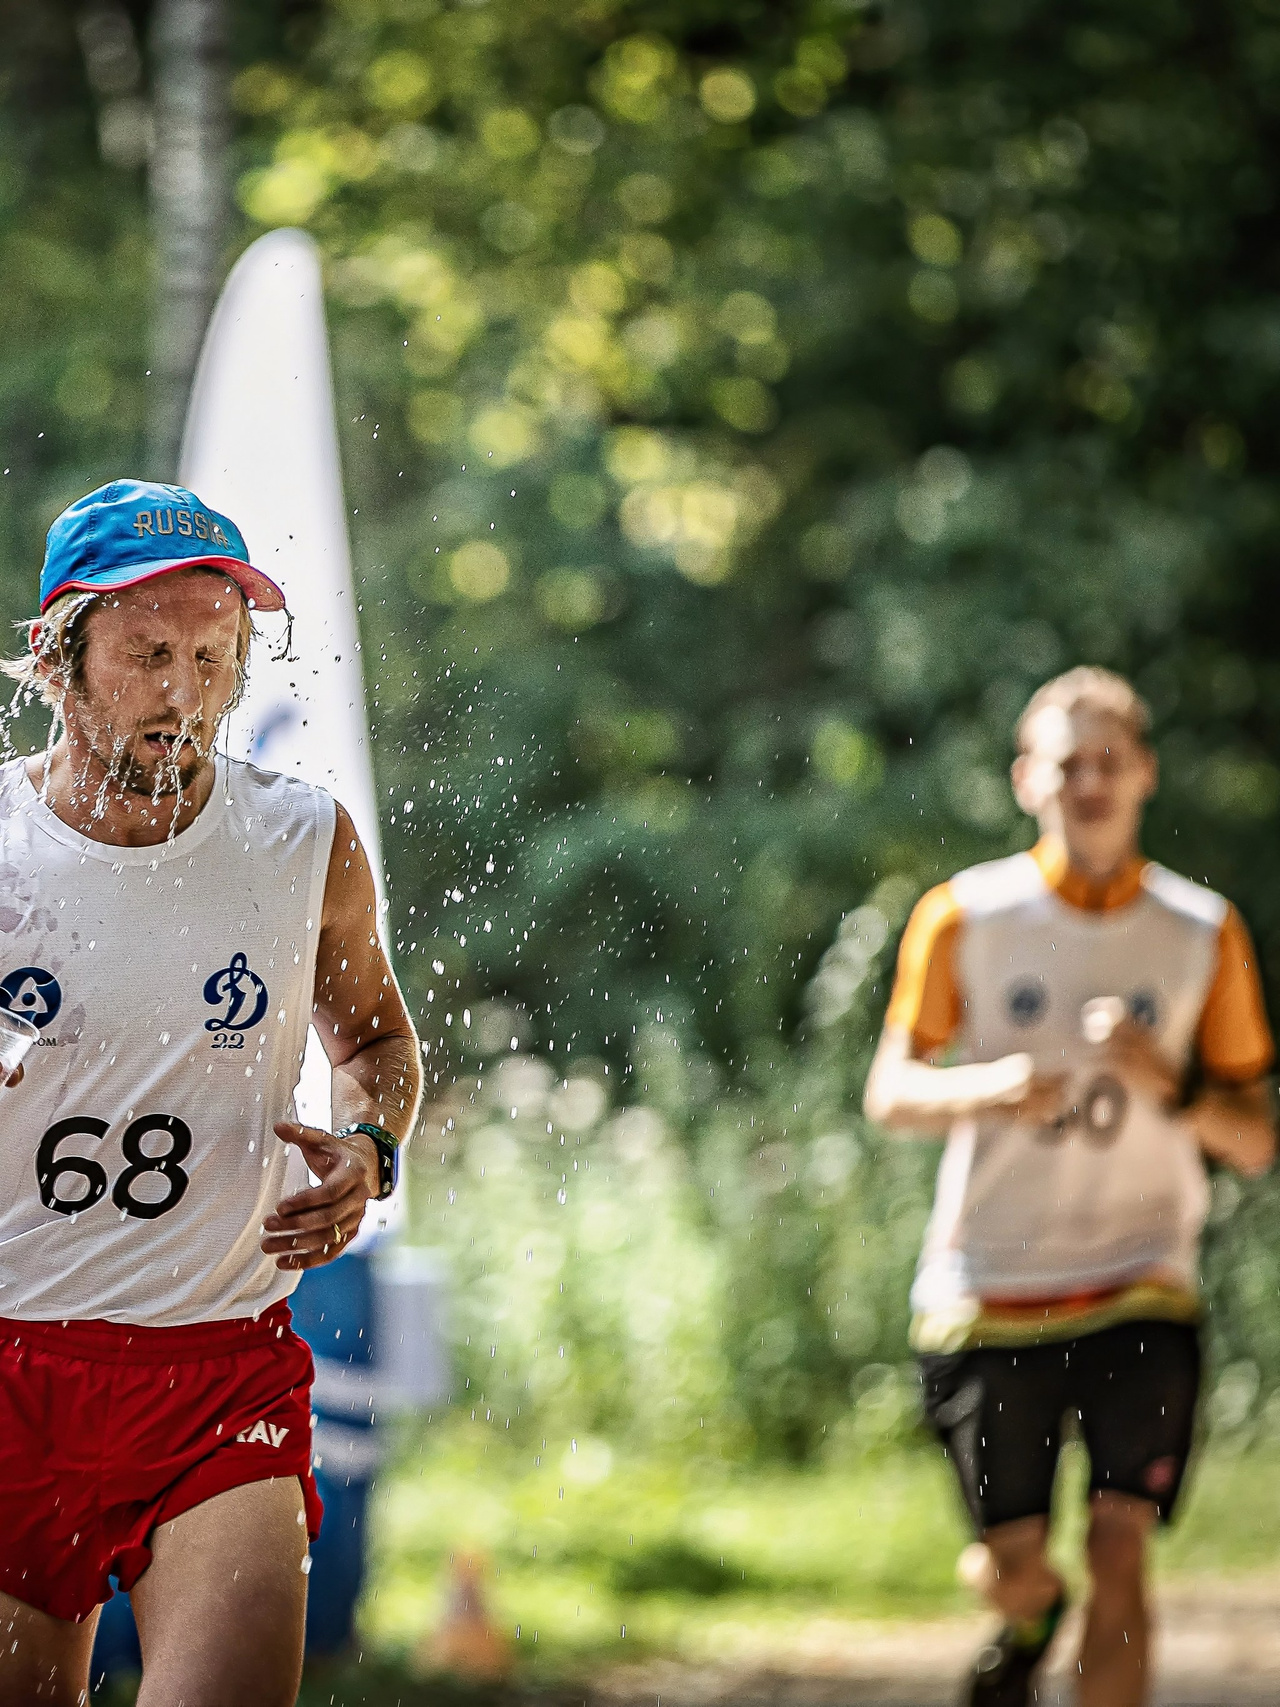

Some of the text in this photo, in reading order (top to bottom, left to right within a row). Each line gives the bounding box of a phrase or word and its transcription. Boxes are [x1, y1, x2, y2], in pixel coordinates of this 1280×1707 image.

[133, 508, 230, 550] RUSSIA
[210, 1032, 246, 1050] 22
[35, 1112, 193, 1220] 68
